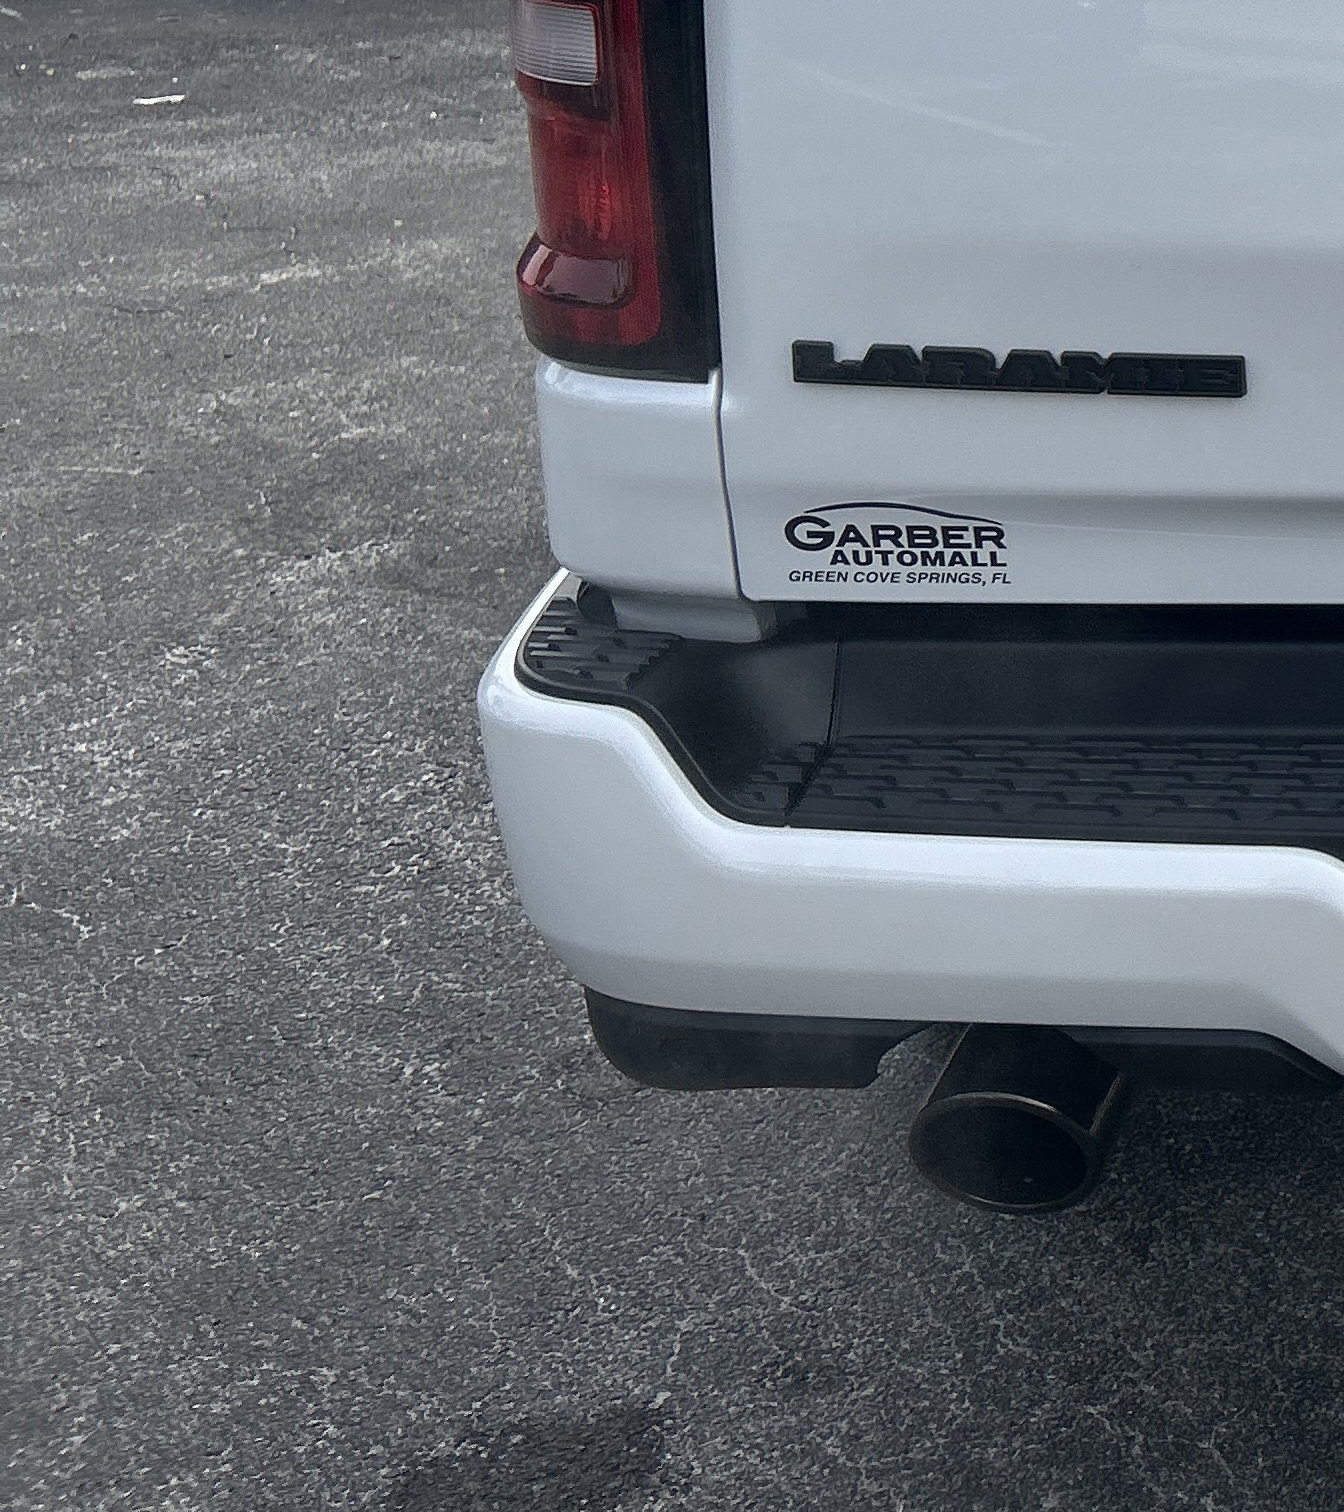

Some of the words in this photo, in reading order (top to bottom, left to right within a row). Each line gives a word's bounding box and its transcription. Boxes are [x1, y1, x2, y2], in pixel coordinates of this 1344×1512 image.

[792, 339, 1247, 398] LARAMIE
[784, 515, 1007, 551] GARBER
[829, 549, 1007, 567] AUTOMALL
[788, 570, 848, 583] GREEN
[853, 570, 902, 585] COVE
[905, 571, 987, 588] SPRINGS,
[992, 572, 1012, 584] FL
